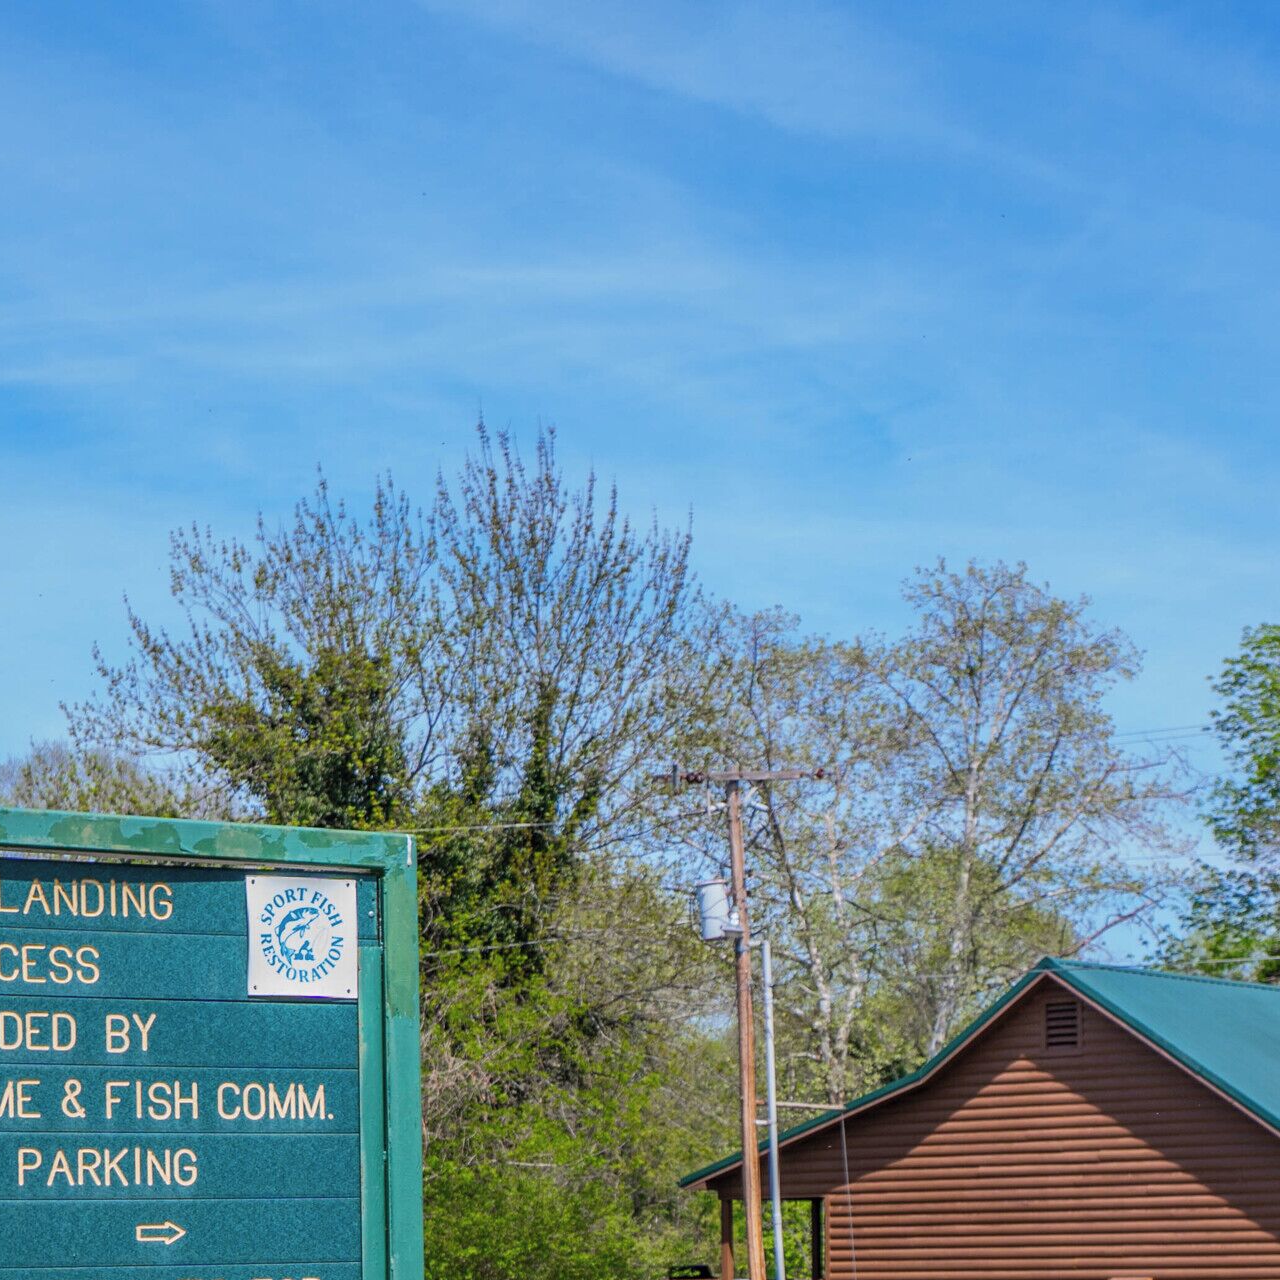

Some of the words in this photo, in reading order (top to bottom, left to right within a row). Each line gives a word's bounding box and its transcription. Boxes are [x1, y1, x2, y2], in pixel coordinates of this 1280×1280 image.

[261, 887, 307, 926] SPORT
[310, 891, 343, 927] FISH
[260, 933, 344, 983] RESTORATION
[106, 1012, 157, 1054] BY
[60, 1078, 87, 1119] &
[106, 1080, 199, 1120] FISH
[217, 1081, 334, 1121] COMM.
[18, 1147, 199, 1188] PARKING
